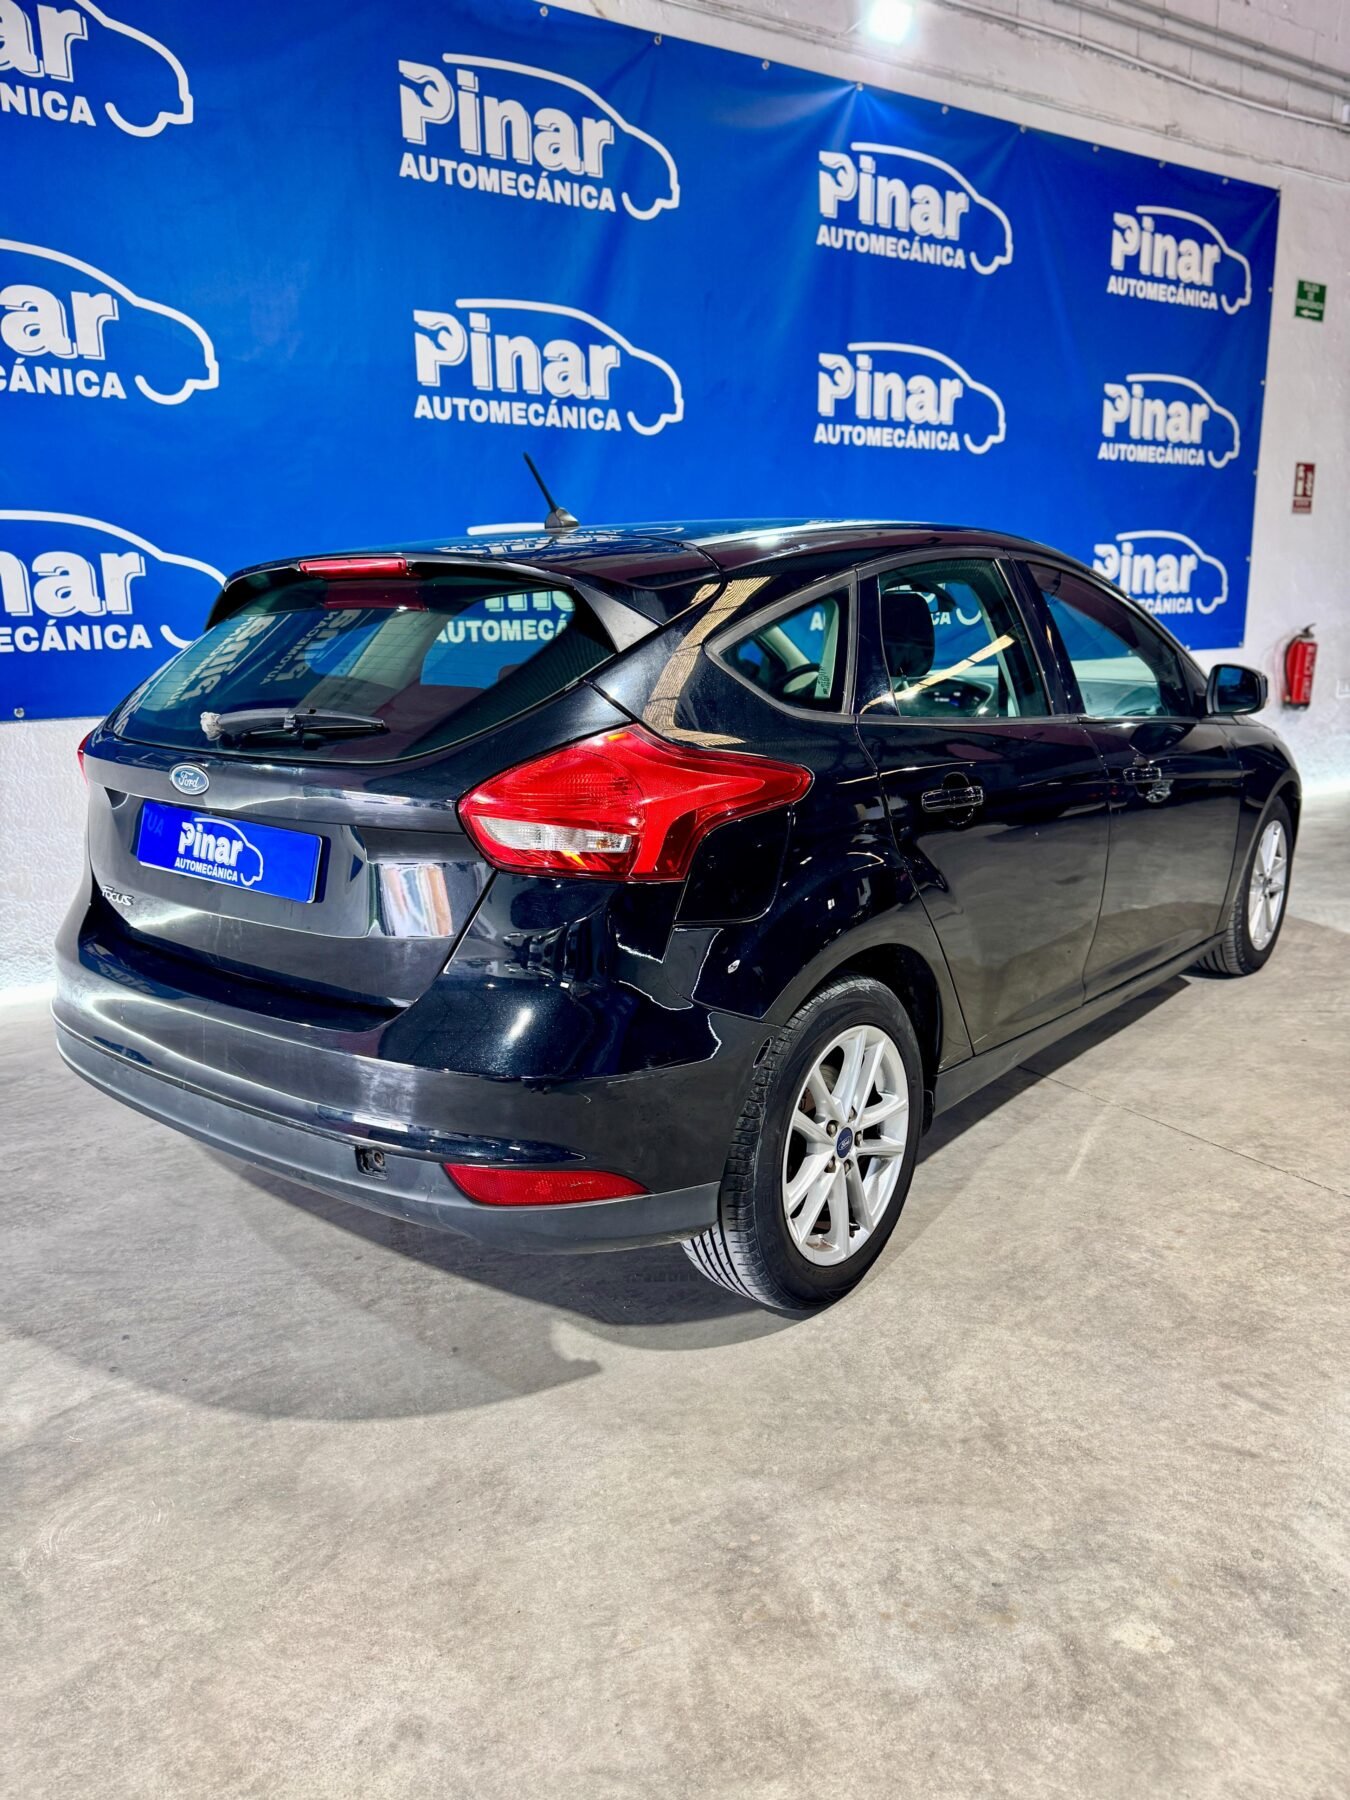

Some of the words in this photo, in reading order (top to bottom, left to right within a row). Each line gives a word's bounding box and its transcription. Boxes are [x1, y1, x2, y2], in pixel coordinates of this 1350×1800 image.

[398, 59, 615, 179] Pinar
[398, 152, 617, 212] AUTOMECÁNICA
[818, 150, 969, 241] Pinar
[816, 224, 967, 270] AUTOMECÁNICA
[1110, 212, 1221, 287] Pinar
[1106, 274, 1219, 311] AUTOMECÁNICA
[412, 309, 621, 401] Pinar
[413, 394, 622, 432] AUTOMECÁNICA
[817, 352, 963, 426] Pinar
[1101, 382, 1210, 444] Pinar
[813, 422, 960, 451] AUTOMECÁNICA
[1097, 441, 1206, 467] AUTOMECÁNICA
[1092, 541, 1198, 595] Pinar
[174, 856, 239, 883] AUTOMECÁNICA
[177, 821, 244, 867] Pinar
